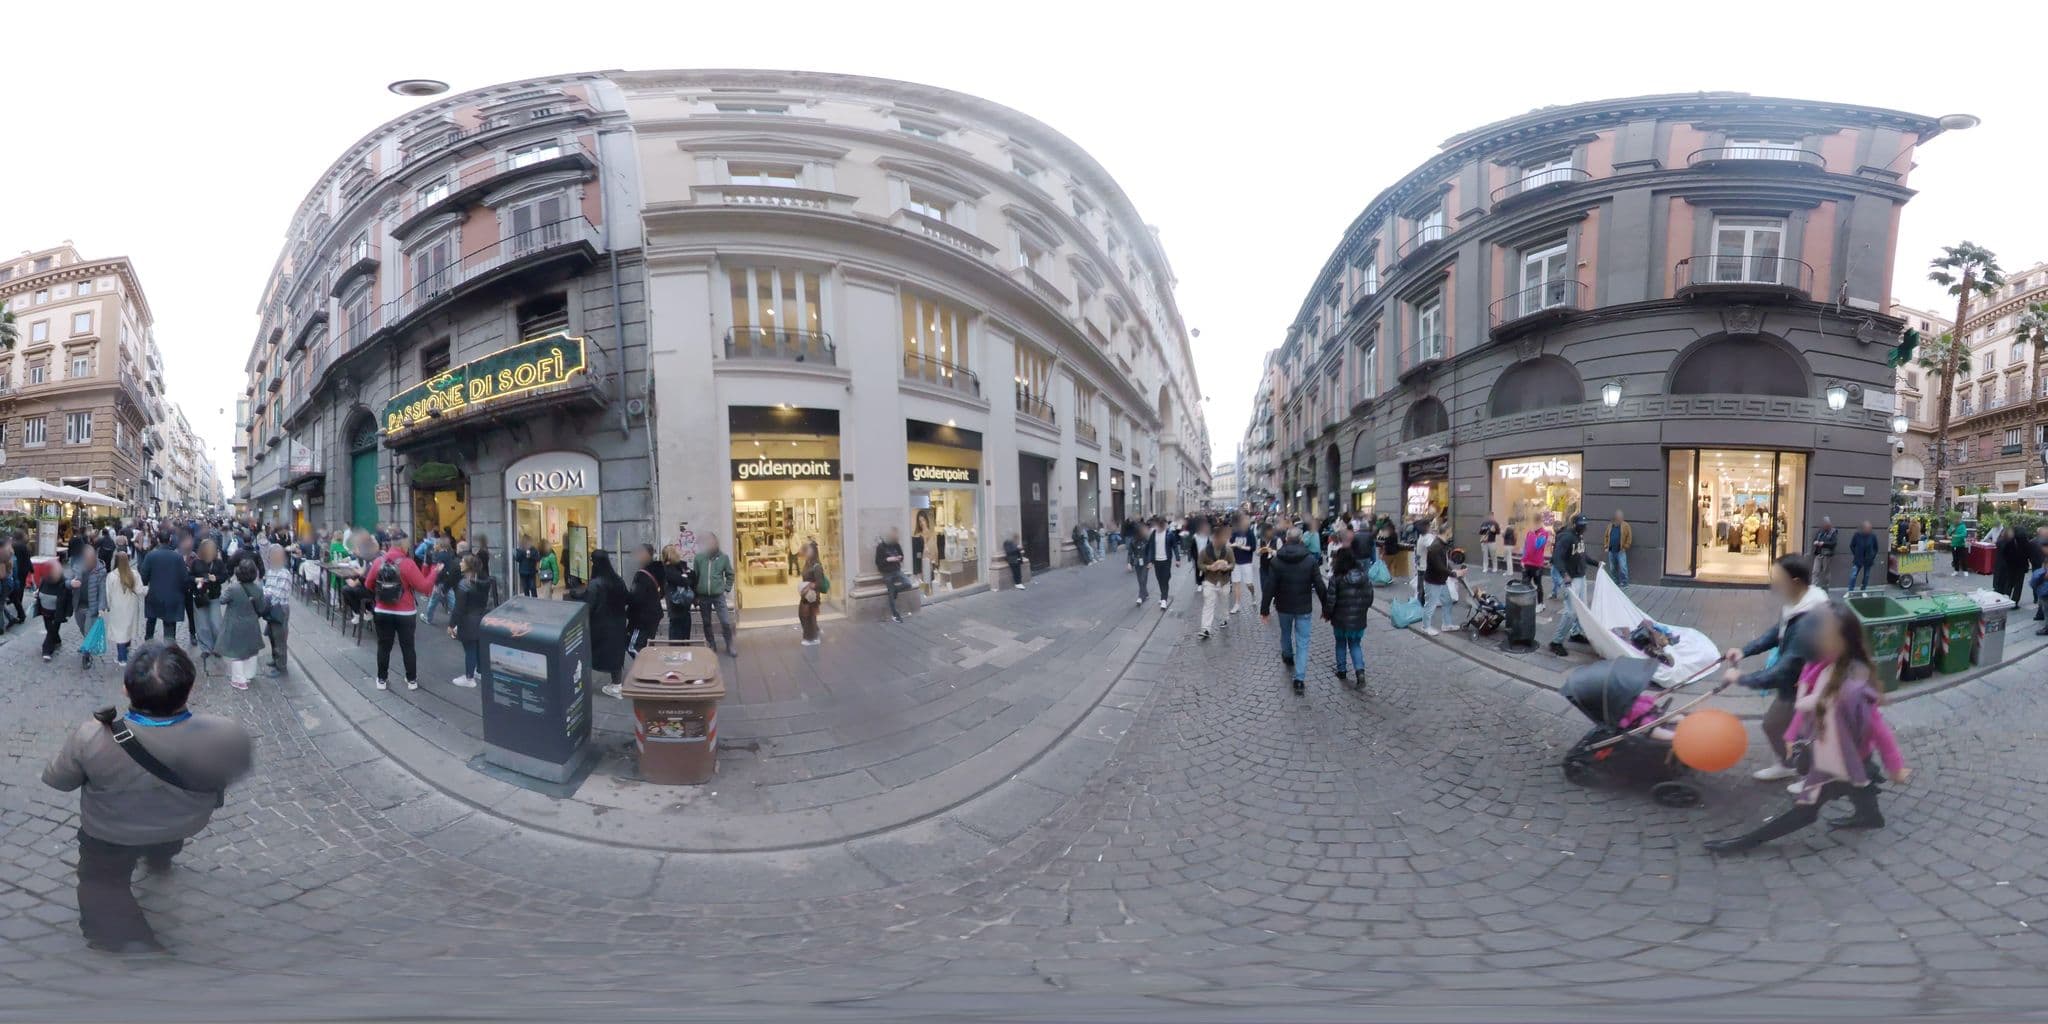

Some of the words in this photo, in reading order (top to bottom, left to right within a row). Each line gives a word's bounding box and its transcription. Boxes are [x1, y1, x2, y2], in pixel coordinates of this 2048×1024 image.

[388, 384, 465, 430] PASSIONE
[469, 374, 493, 400] DI
[498, 347, 564, 391] SOFÌ
[738, 459, 831, 479] goldenpoint
[912, 466, 969, 482] goldenpoint
[1499, 457, 1570, 480] TEZENIS
[515, 469, 584, 494] GROM
